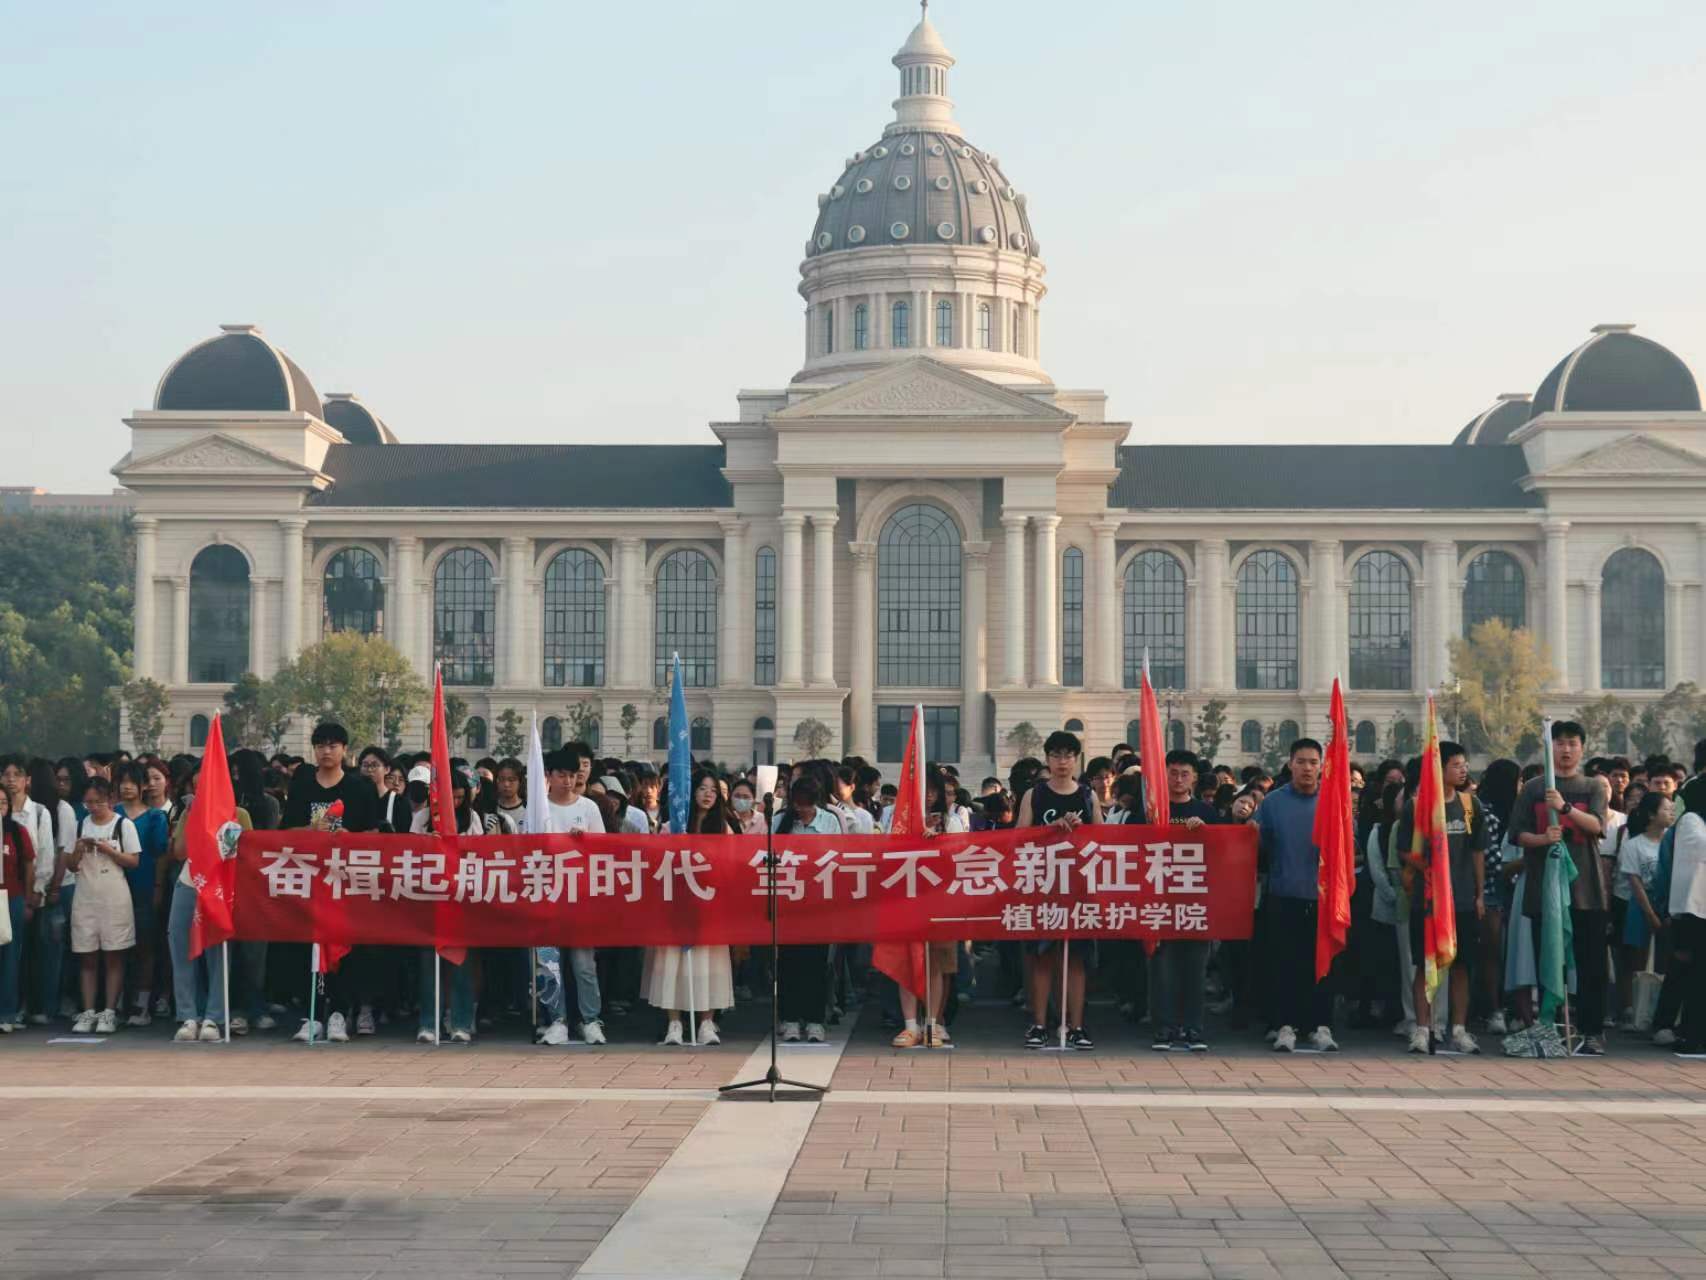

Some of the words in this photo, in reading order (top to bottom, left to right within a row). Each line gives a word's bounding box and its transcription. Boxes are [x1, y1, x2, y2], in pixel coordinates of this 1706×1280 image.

[260, 847, 716, 903] 奋楫起航新时代
[749, 840, 1209, 902] 笃行不怠新征程
